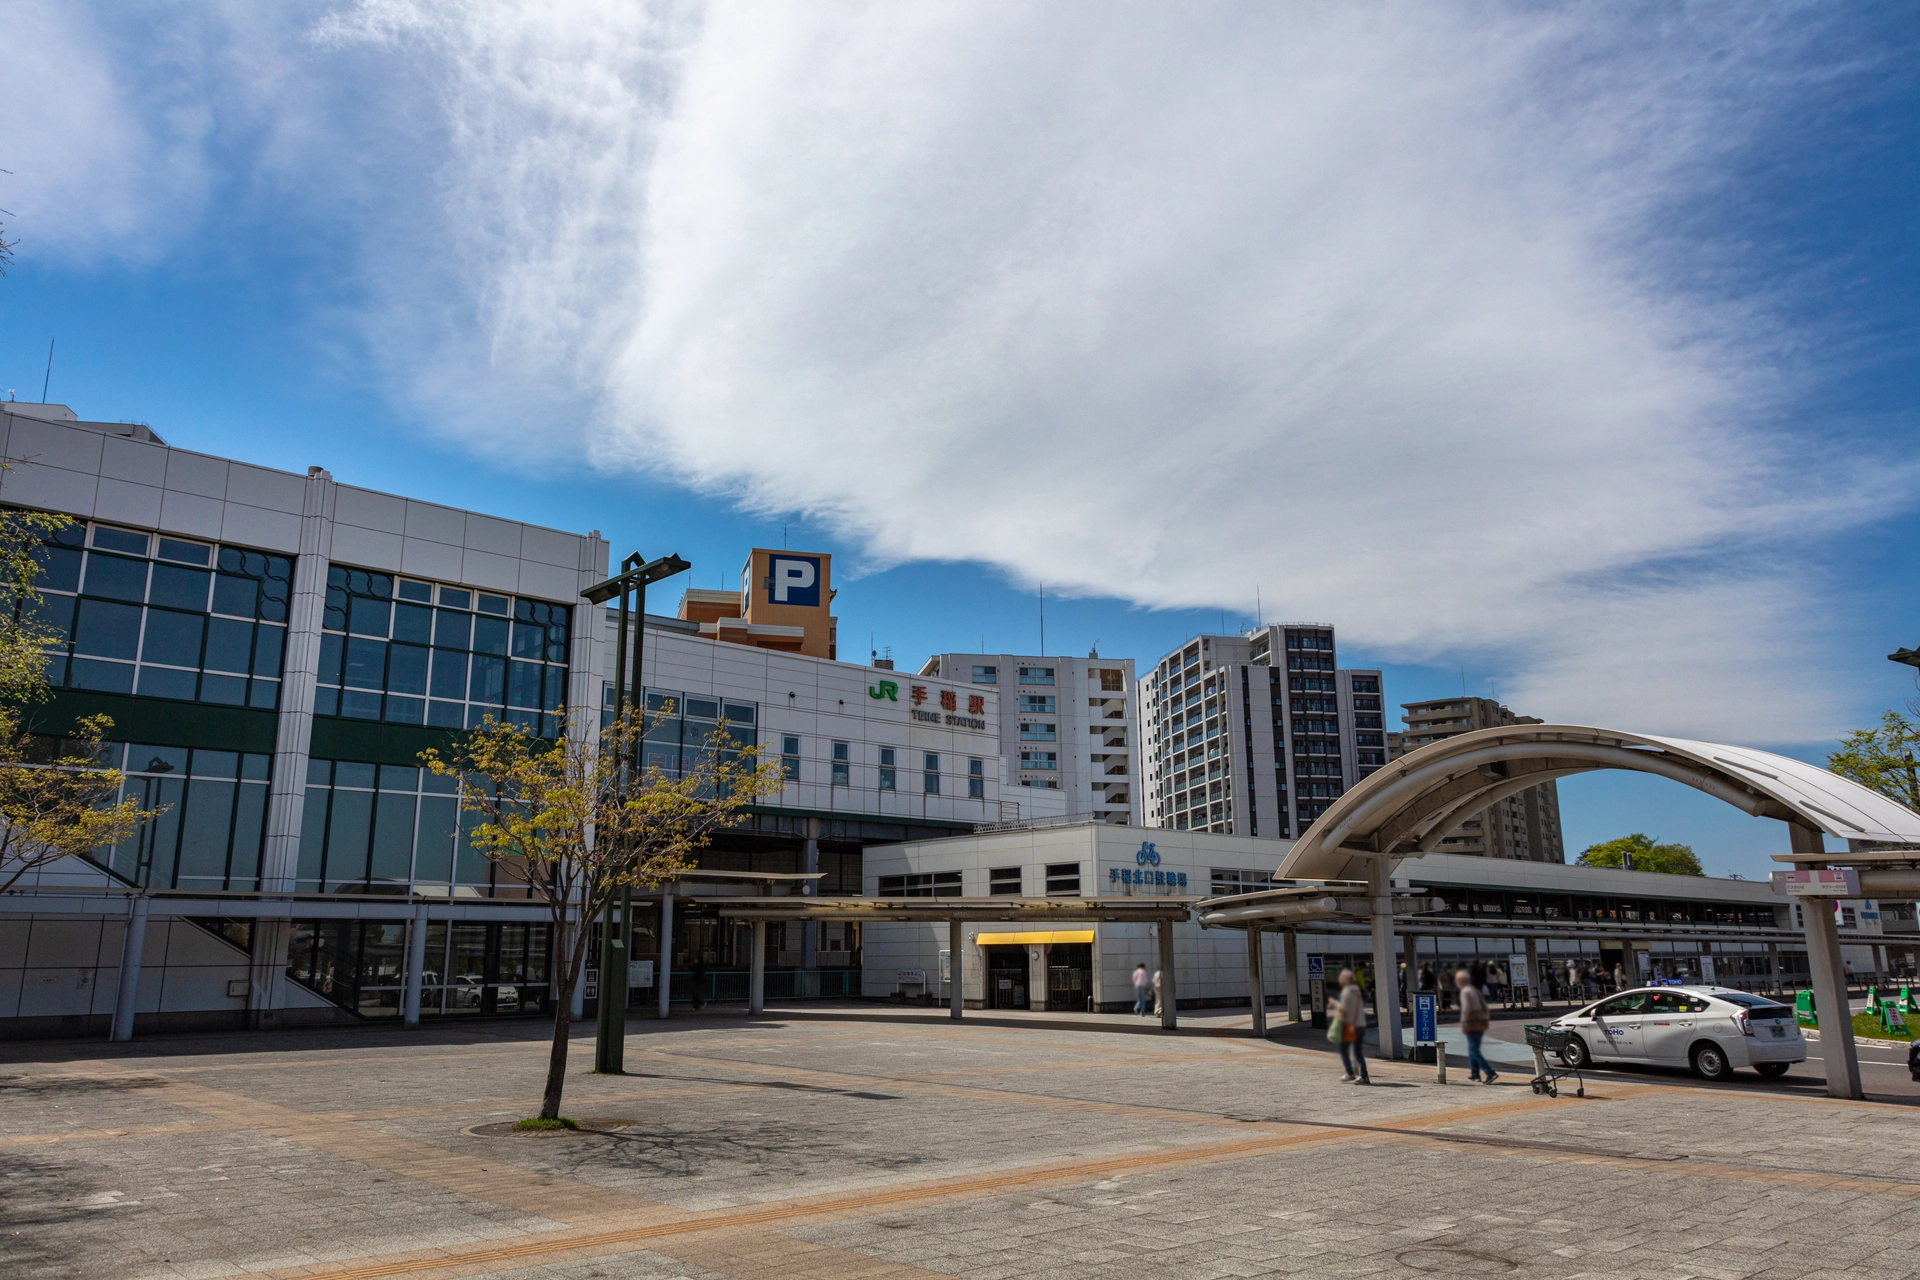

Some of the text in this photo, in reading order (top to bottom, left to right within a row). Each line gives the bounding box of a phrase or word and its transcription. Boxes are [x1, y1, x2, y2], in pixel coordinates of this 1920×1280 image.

[743, 566, 750, 614] P
[775, 559, 815, 602] P
[869, 680, 899, 702] JR
[911, 686, 985, 715] 手稲駅
[911, 709, 986, 730] TEINE STATION
